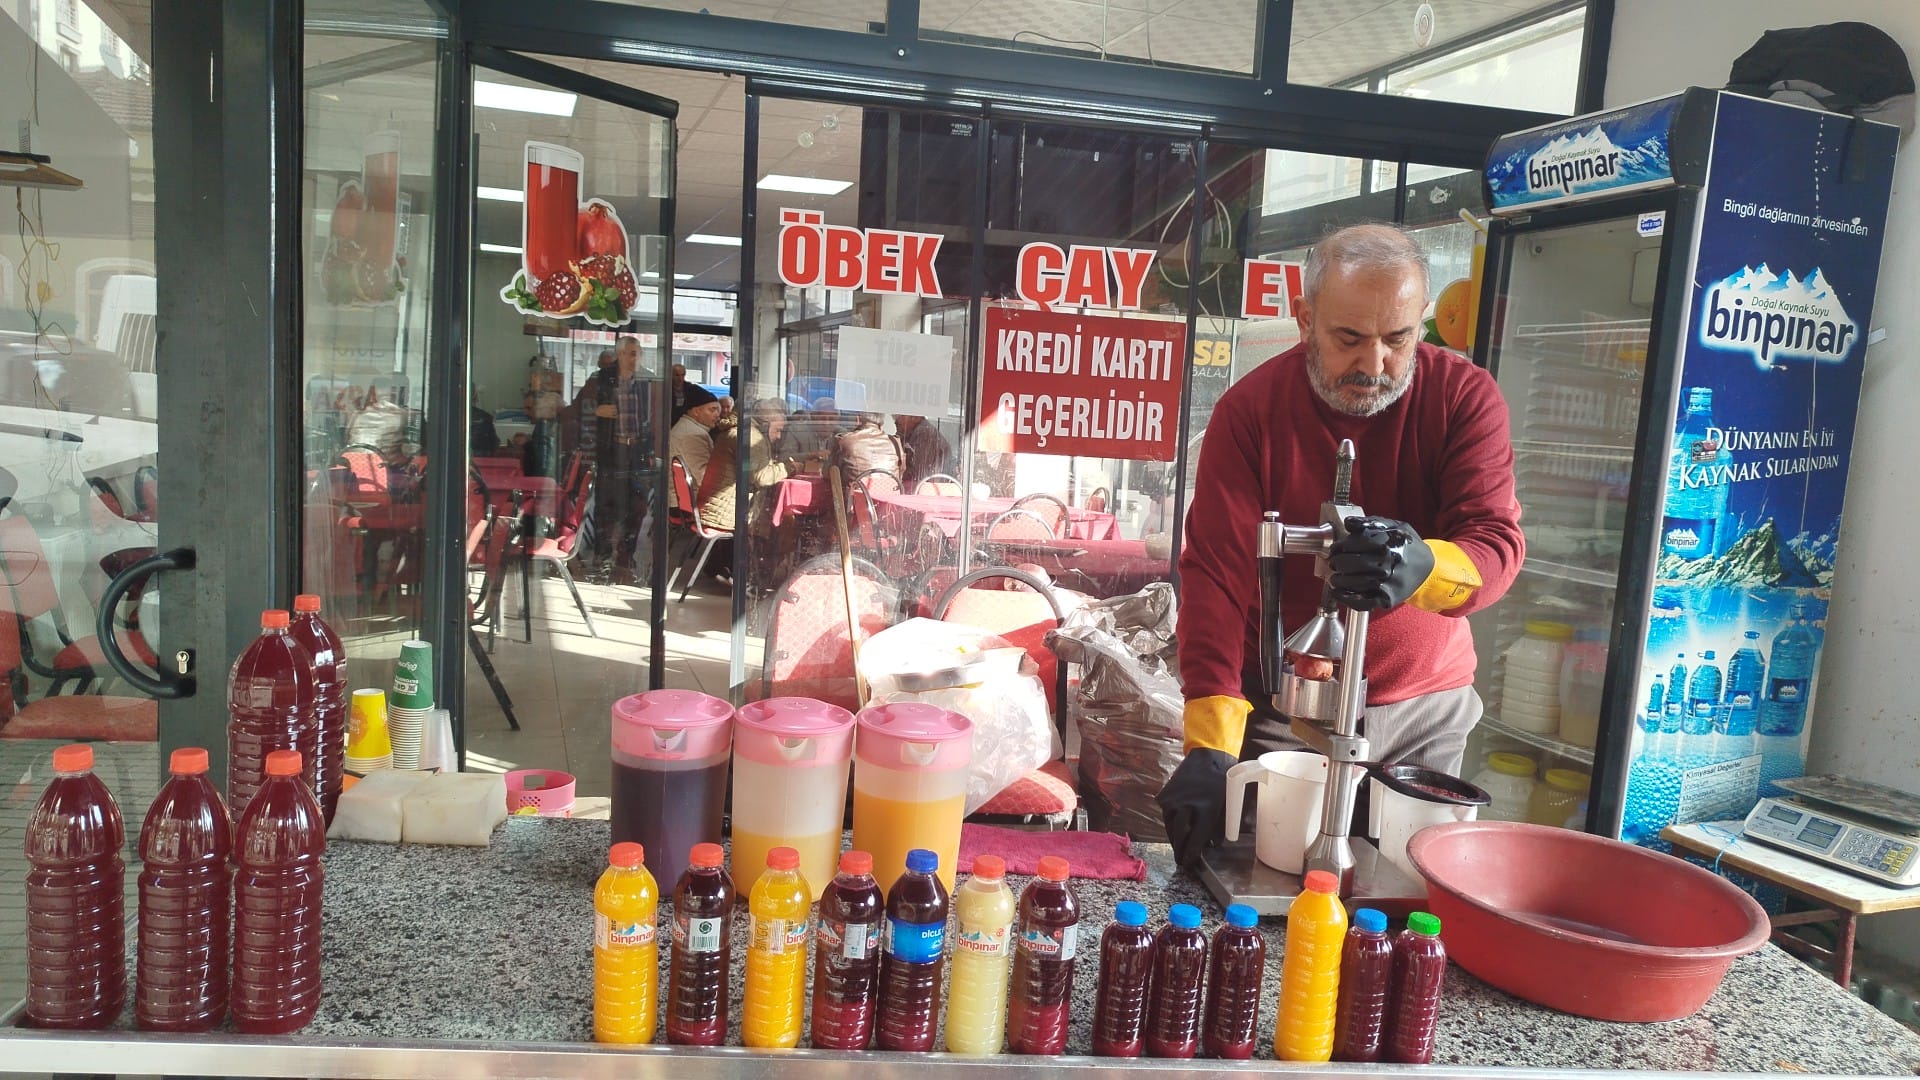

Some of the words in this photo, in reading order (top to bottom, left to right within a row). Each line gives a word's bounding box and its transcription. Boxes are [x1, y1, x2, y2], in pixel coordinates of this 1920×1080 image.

[1723, 198, 1757, 219] Bingöl
[1758, 205, 1810, 226] dağlarının
[1811, 216, 1869, 236] zirvesinden
[778, 207, 944, 298] ÖBEK
[1016, 242, 1157, 311] ÇAY
[1706, 289, 1854, 361] binpınar
[1751, 296, 1777, 311] Doğal
[1778, 300, 1809, 314] Kaynak
[1809, 305, 1830, 318] Suyu
[996, 324, 1082, 377] KREDİ
[1090, 334, 1173, 382] KARTI
[998, 389, 1165, 448] GEÇERLİDİR
[1678, 460, 1762, 491] KAYNAK
[1765, 454, 1839, 478] SULARINDAN
